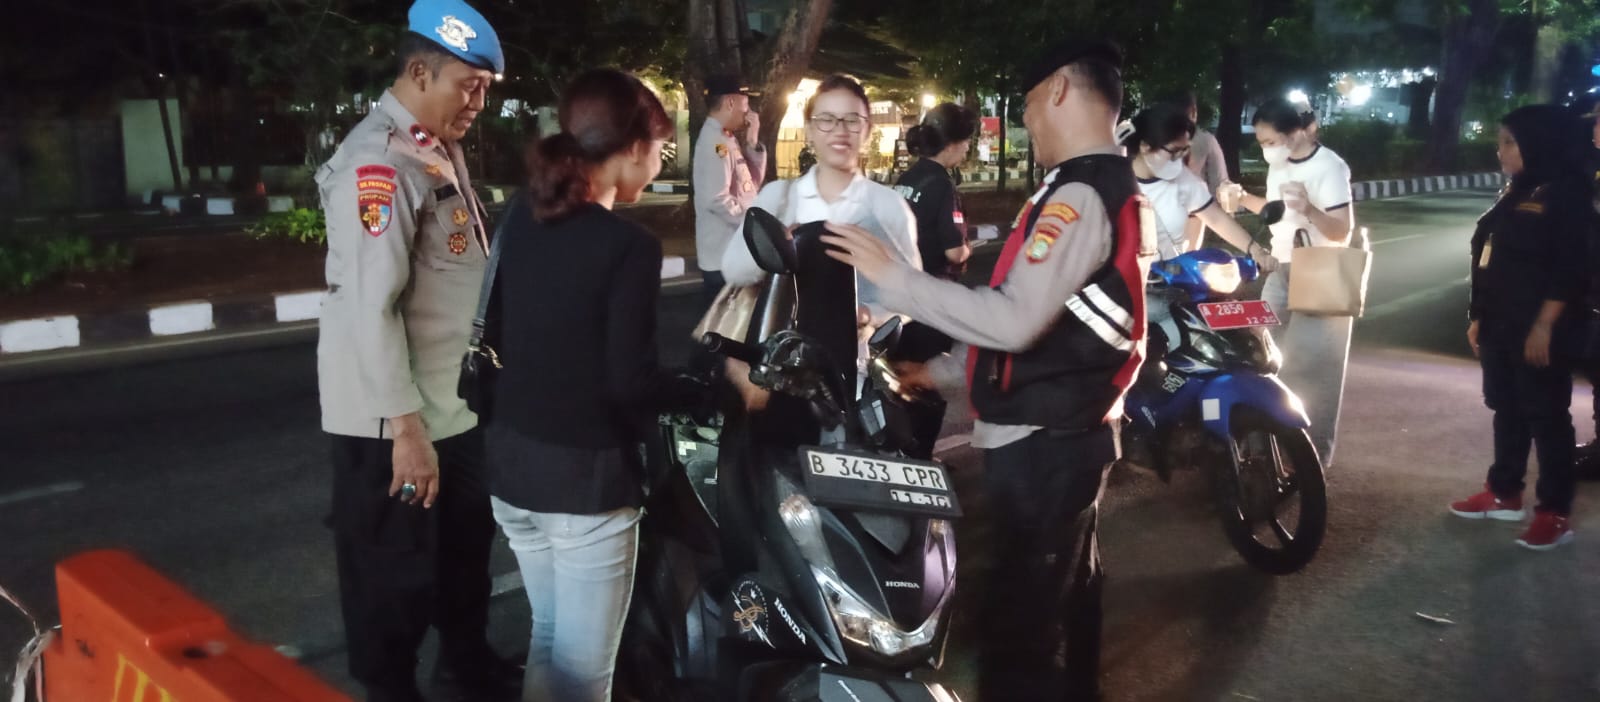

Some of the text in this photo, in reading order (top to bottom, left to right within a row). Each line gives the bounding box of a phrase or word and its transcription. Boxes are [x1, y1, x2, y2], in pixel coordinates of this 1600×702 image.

[1215, 303, 1245, 316] 2859
[811, 454, 944, 489] B 3433 CPR
[885, 580, 920, 589] HONDA
[773, 597, 807, 645] HONDA
